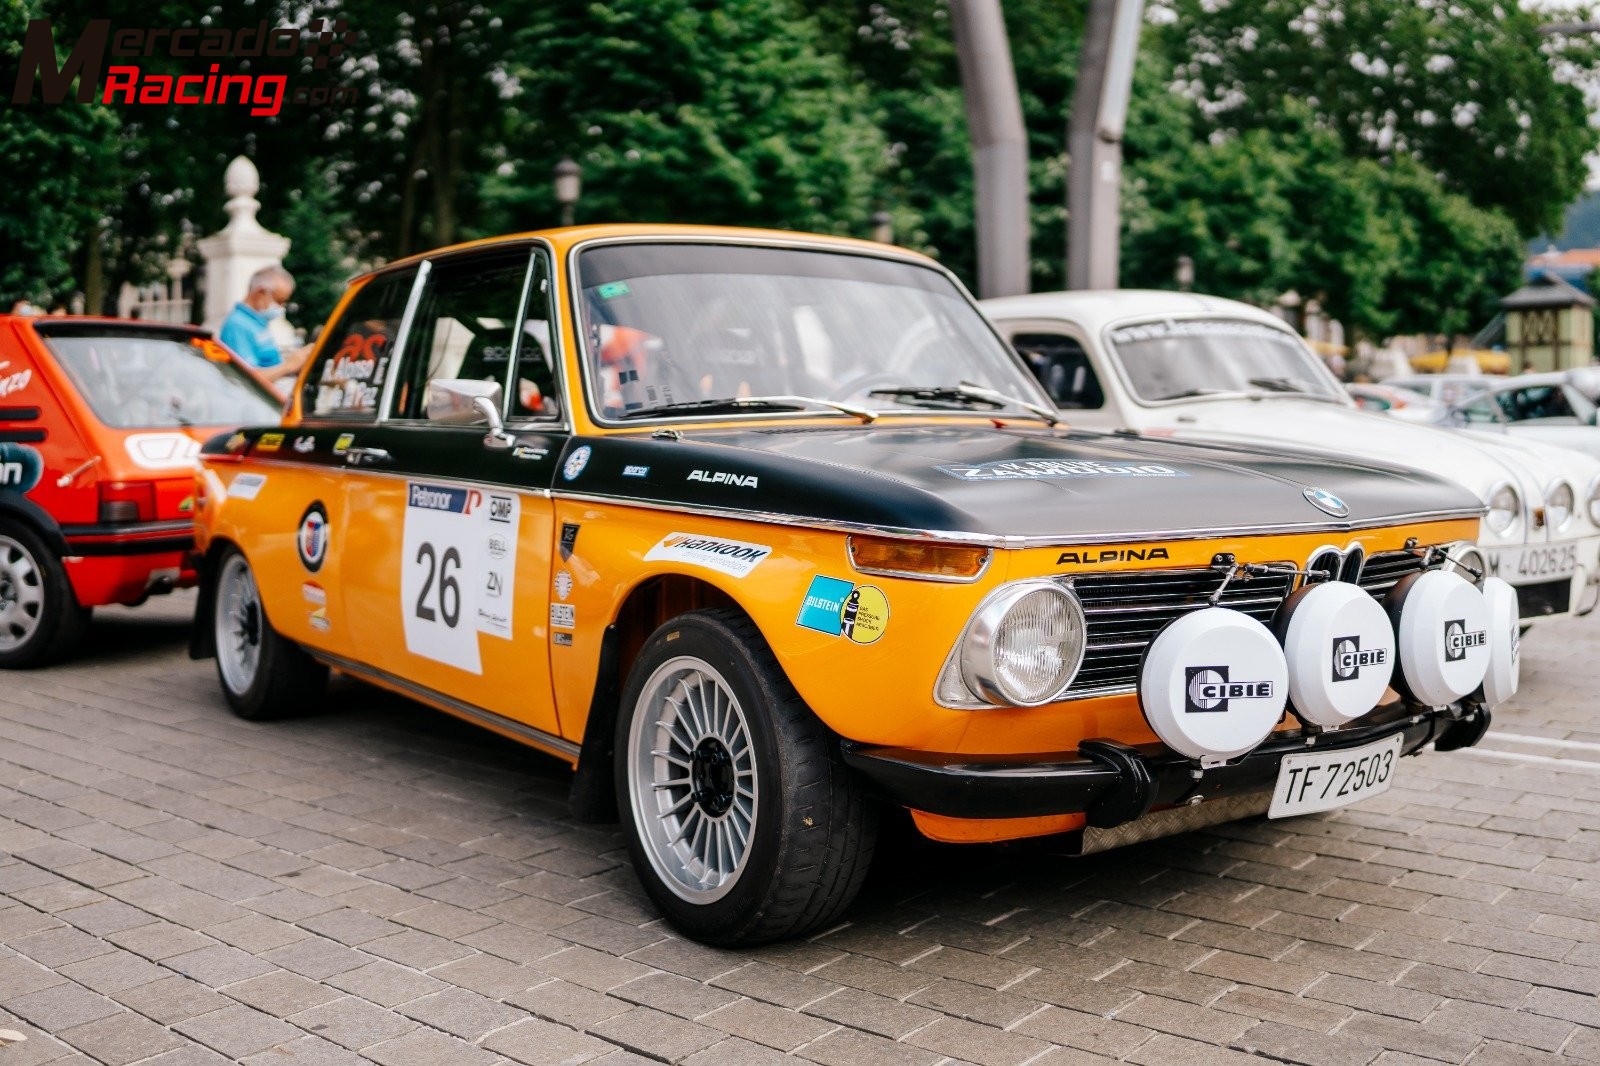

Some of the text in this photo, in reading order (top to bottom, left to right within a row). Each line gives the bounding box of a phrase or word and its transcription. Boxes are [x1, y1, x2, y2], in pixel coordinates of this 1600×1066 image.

[686, 469, 759, 489] ALPINA
[411, 484, 453, 510] Petronor
[490, 500, 512, 519] OMP
[1055, 547, 1170, 565] ALPINA
[416, 541, 461, 628] 26
[806, 595, 840, 613] BILSTEIN
[1285, 748, 1394, 804] TF 72503
